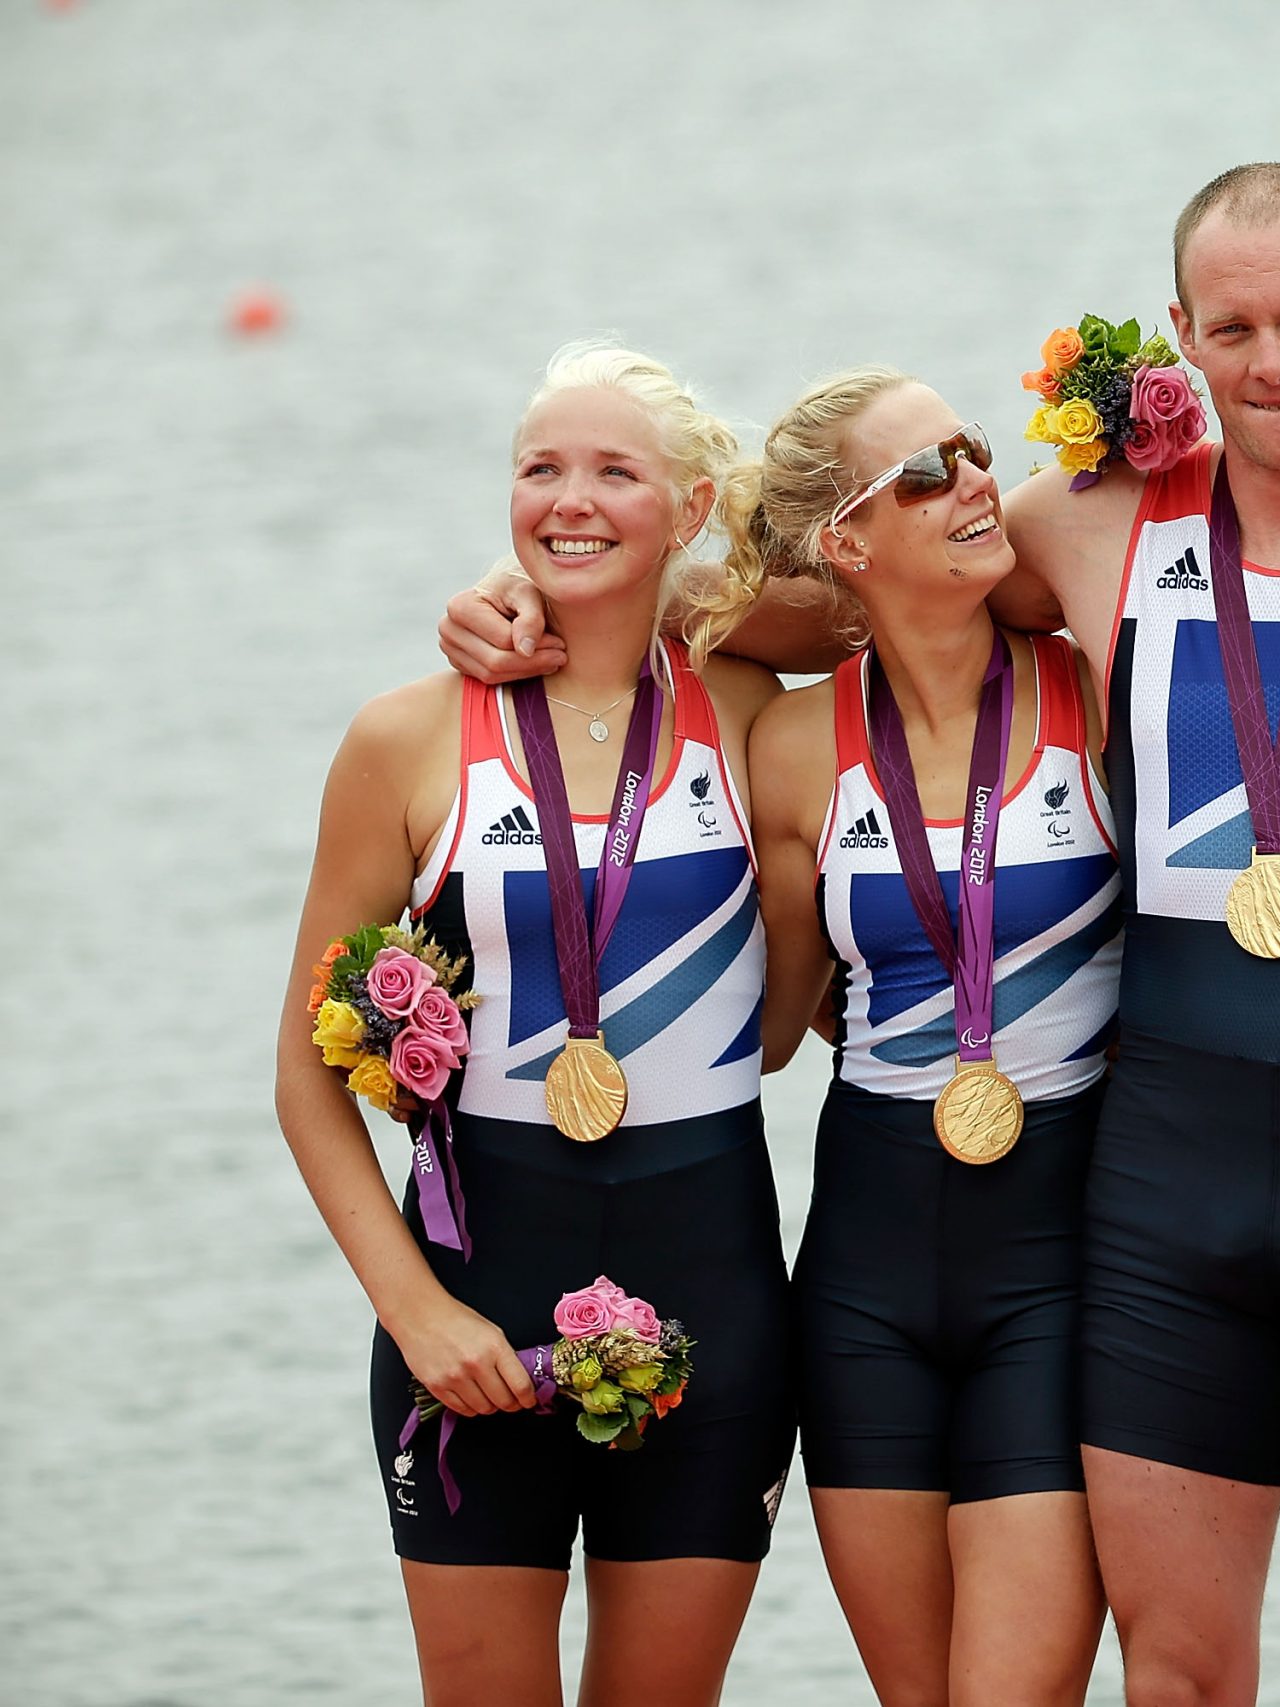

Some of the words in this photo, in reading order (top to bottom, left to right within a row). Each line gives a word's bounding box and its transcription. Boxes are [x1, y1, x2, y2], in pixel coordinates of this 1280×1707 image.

[1156, 573, 1209, 591] adidas
[617, 770, 642, 826] London
[971, 785, 992, 844] London
[481, 830, 544, 845] adidas
[609, 828, 631, 867] 2012
[839, 833, 888, 848] adidas
[968, 847, 986, 886] 2012
[415, 1141, 433, 1175] 2012
